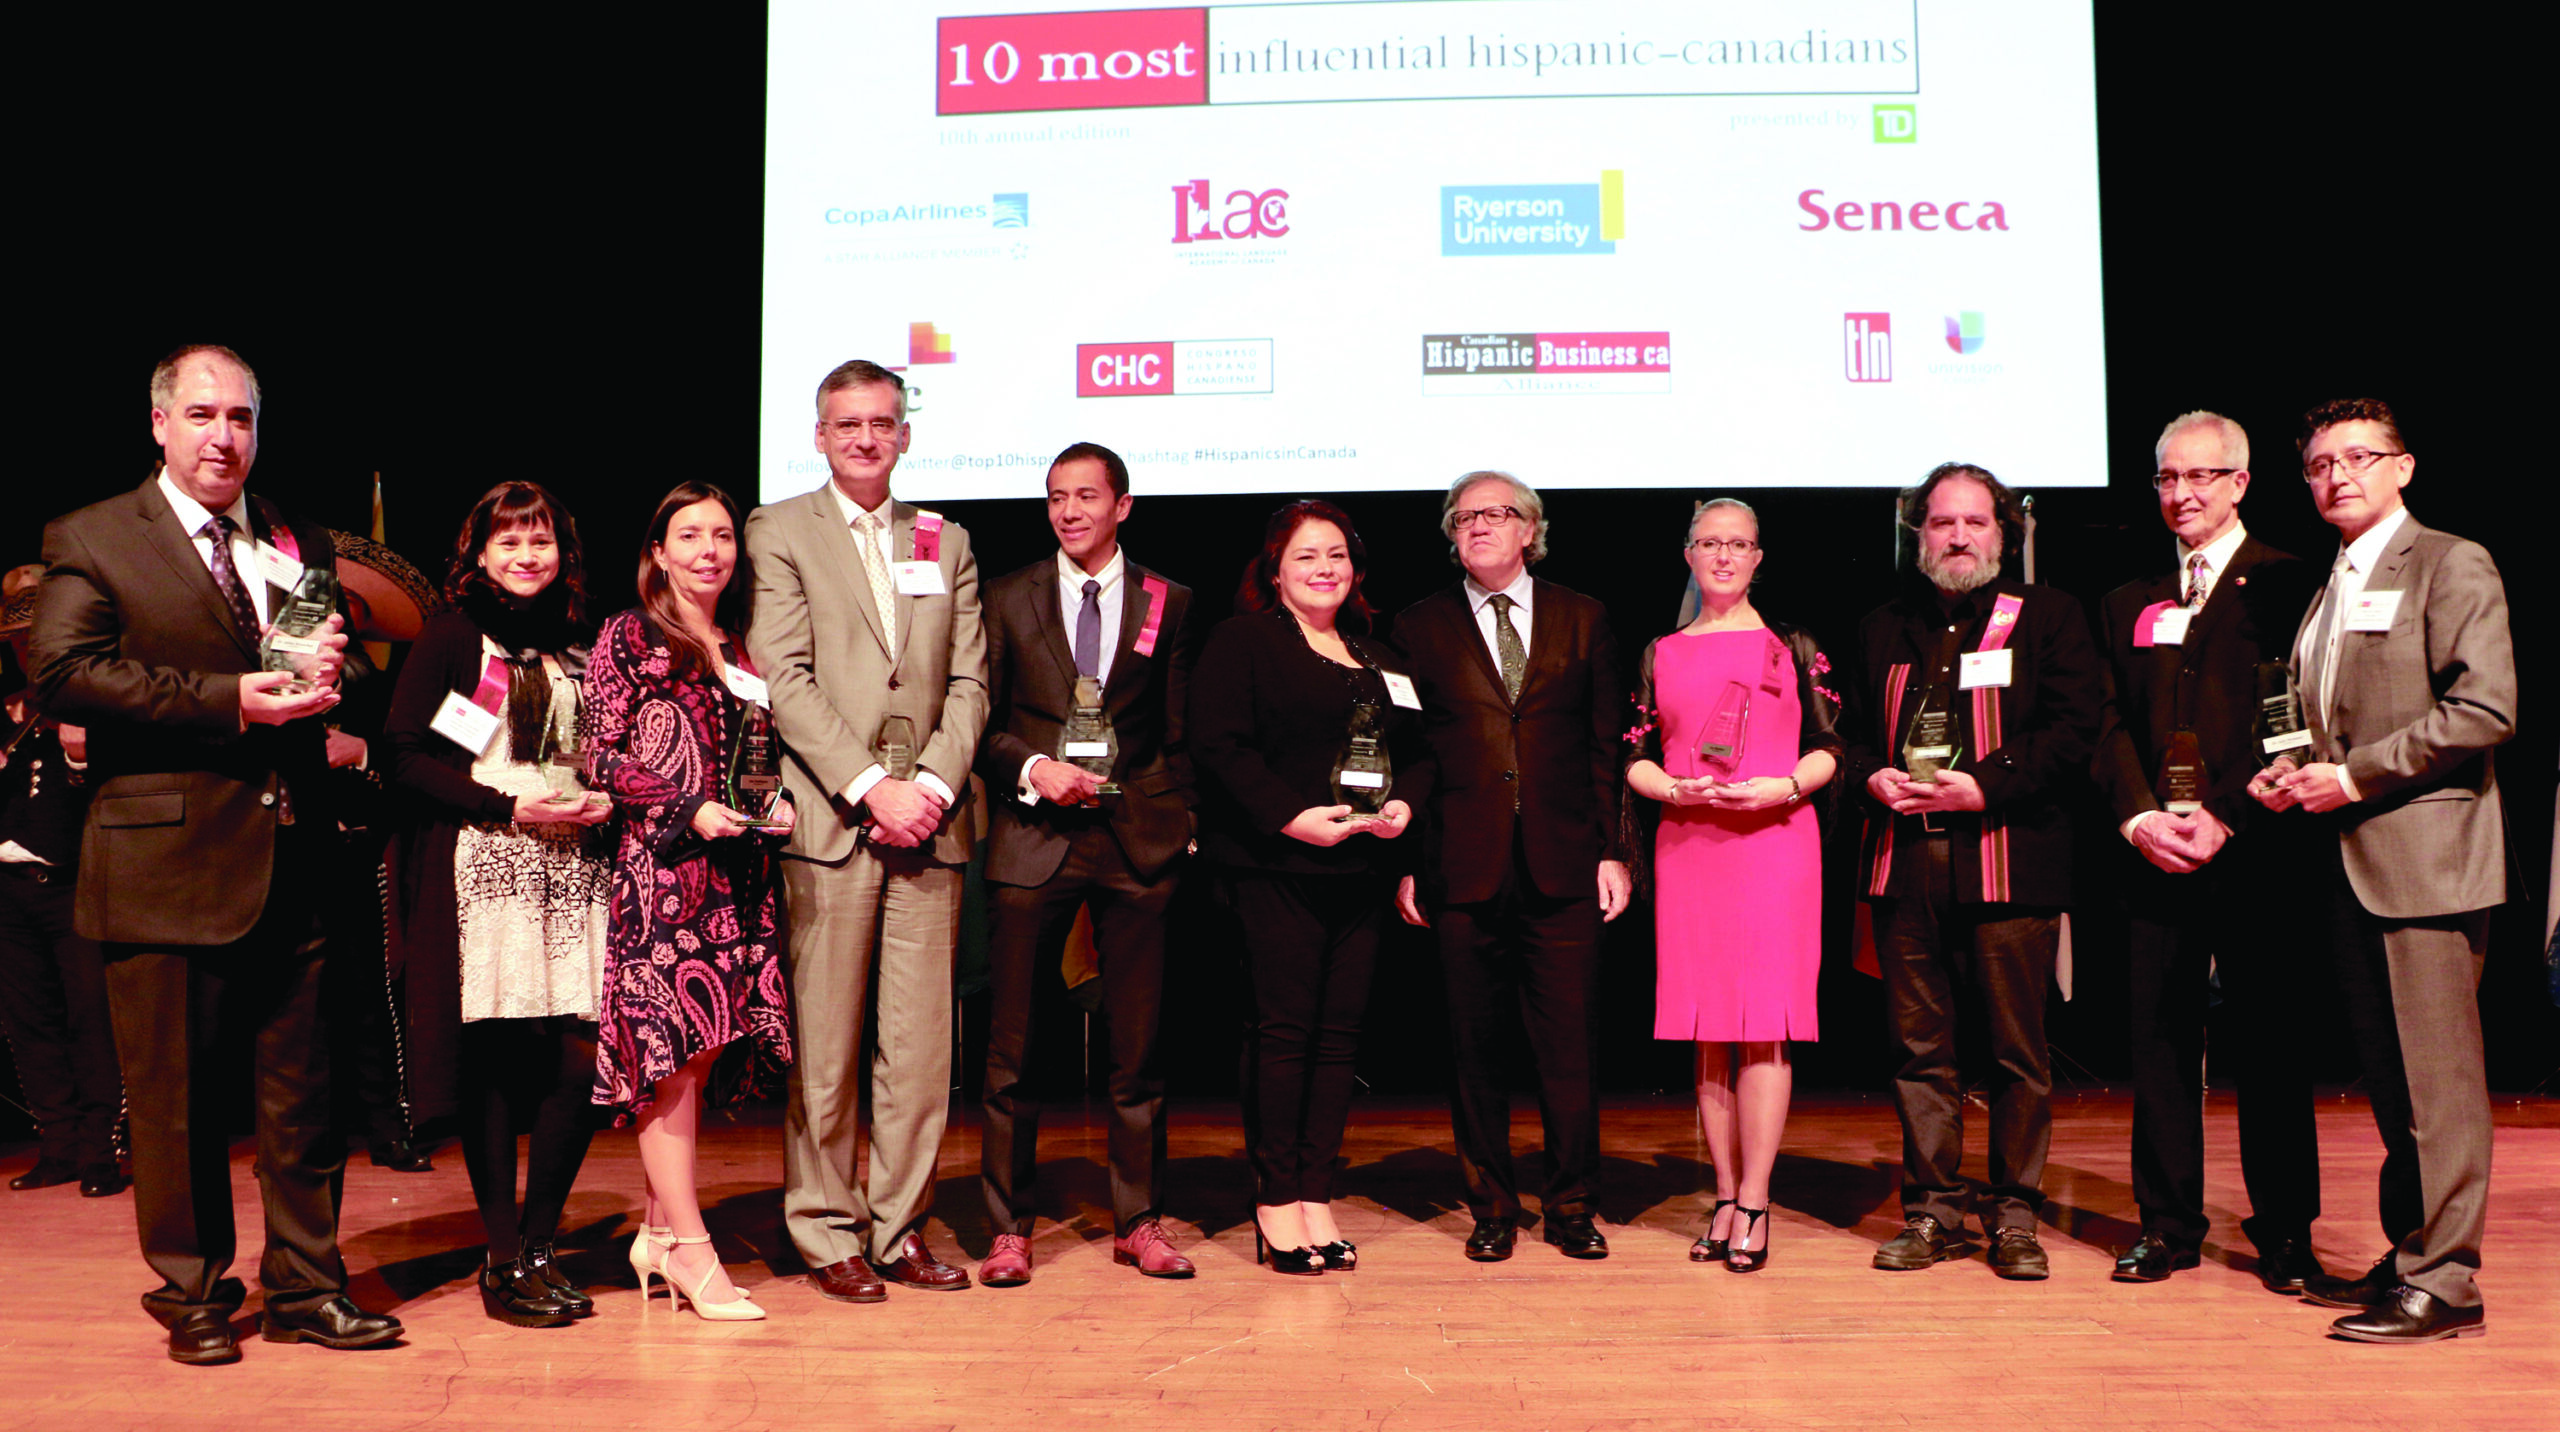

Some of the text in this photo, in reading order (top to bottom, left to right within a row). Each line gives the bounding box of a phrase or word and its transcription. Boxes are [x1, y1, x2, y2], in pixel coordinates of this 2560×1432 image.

[949, 41, 1019, 86] 10
[1039, 42, 1196, 82] most
[1217, 36, 1447, 75] influential
[1729, 108, 1860, 131] presented by
[1876, 110, 1913, 137] TD
[938, 122, 1131, 146] 10th annual edition
[1454, 195, 1564, 221] Ryerson
[1797, 189, 2009, 232] Seneca
[1454, 220, 1590, 248] University
[1426, 339, 1534, 372] Hispanic
[1091, 354, 1160, 386] CHC
[1496, 377, 1601, 391] Alliance
[1127, 447, 1189, 465] hashtag
[1194, 444, 1357, 463] #HispanicsinCanada
